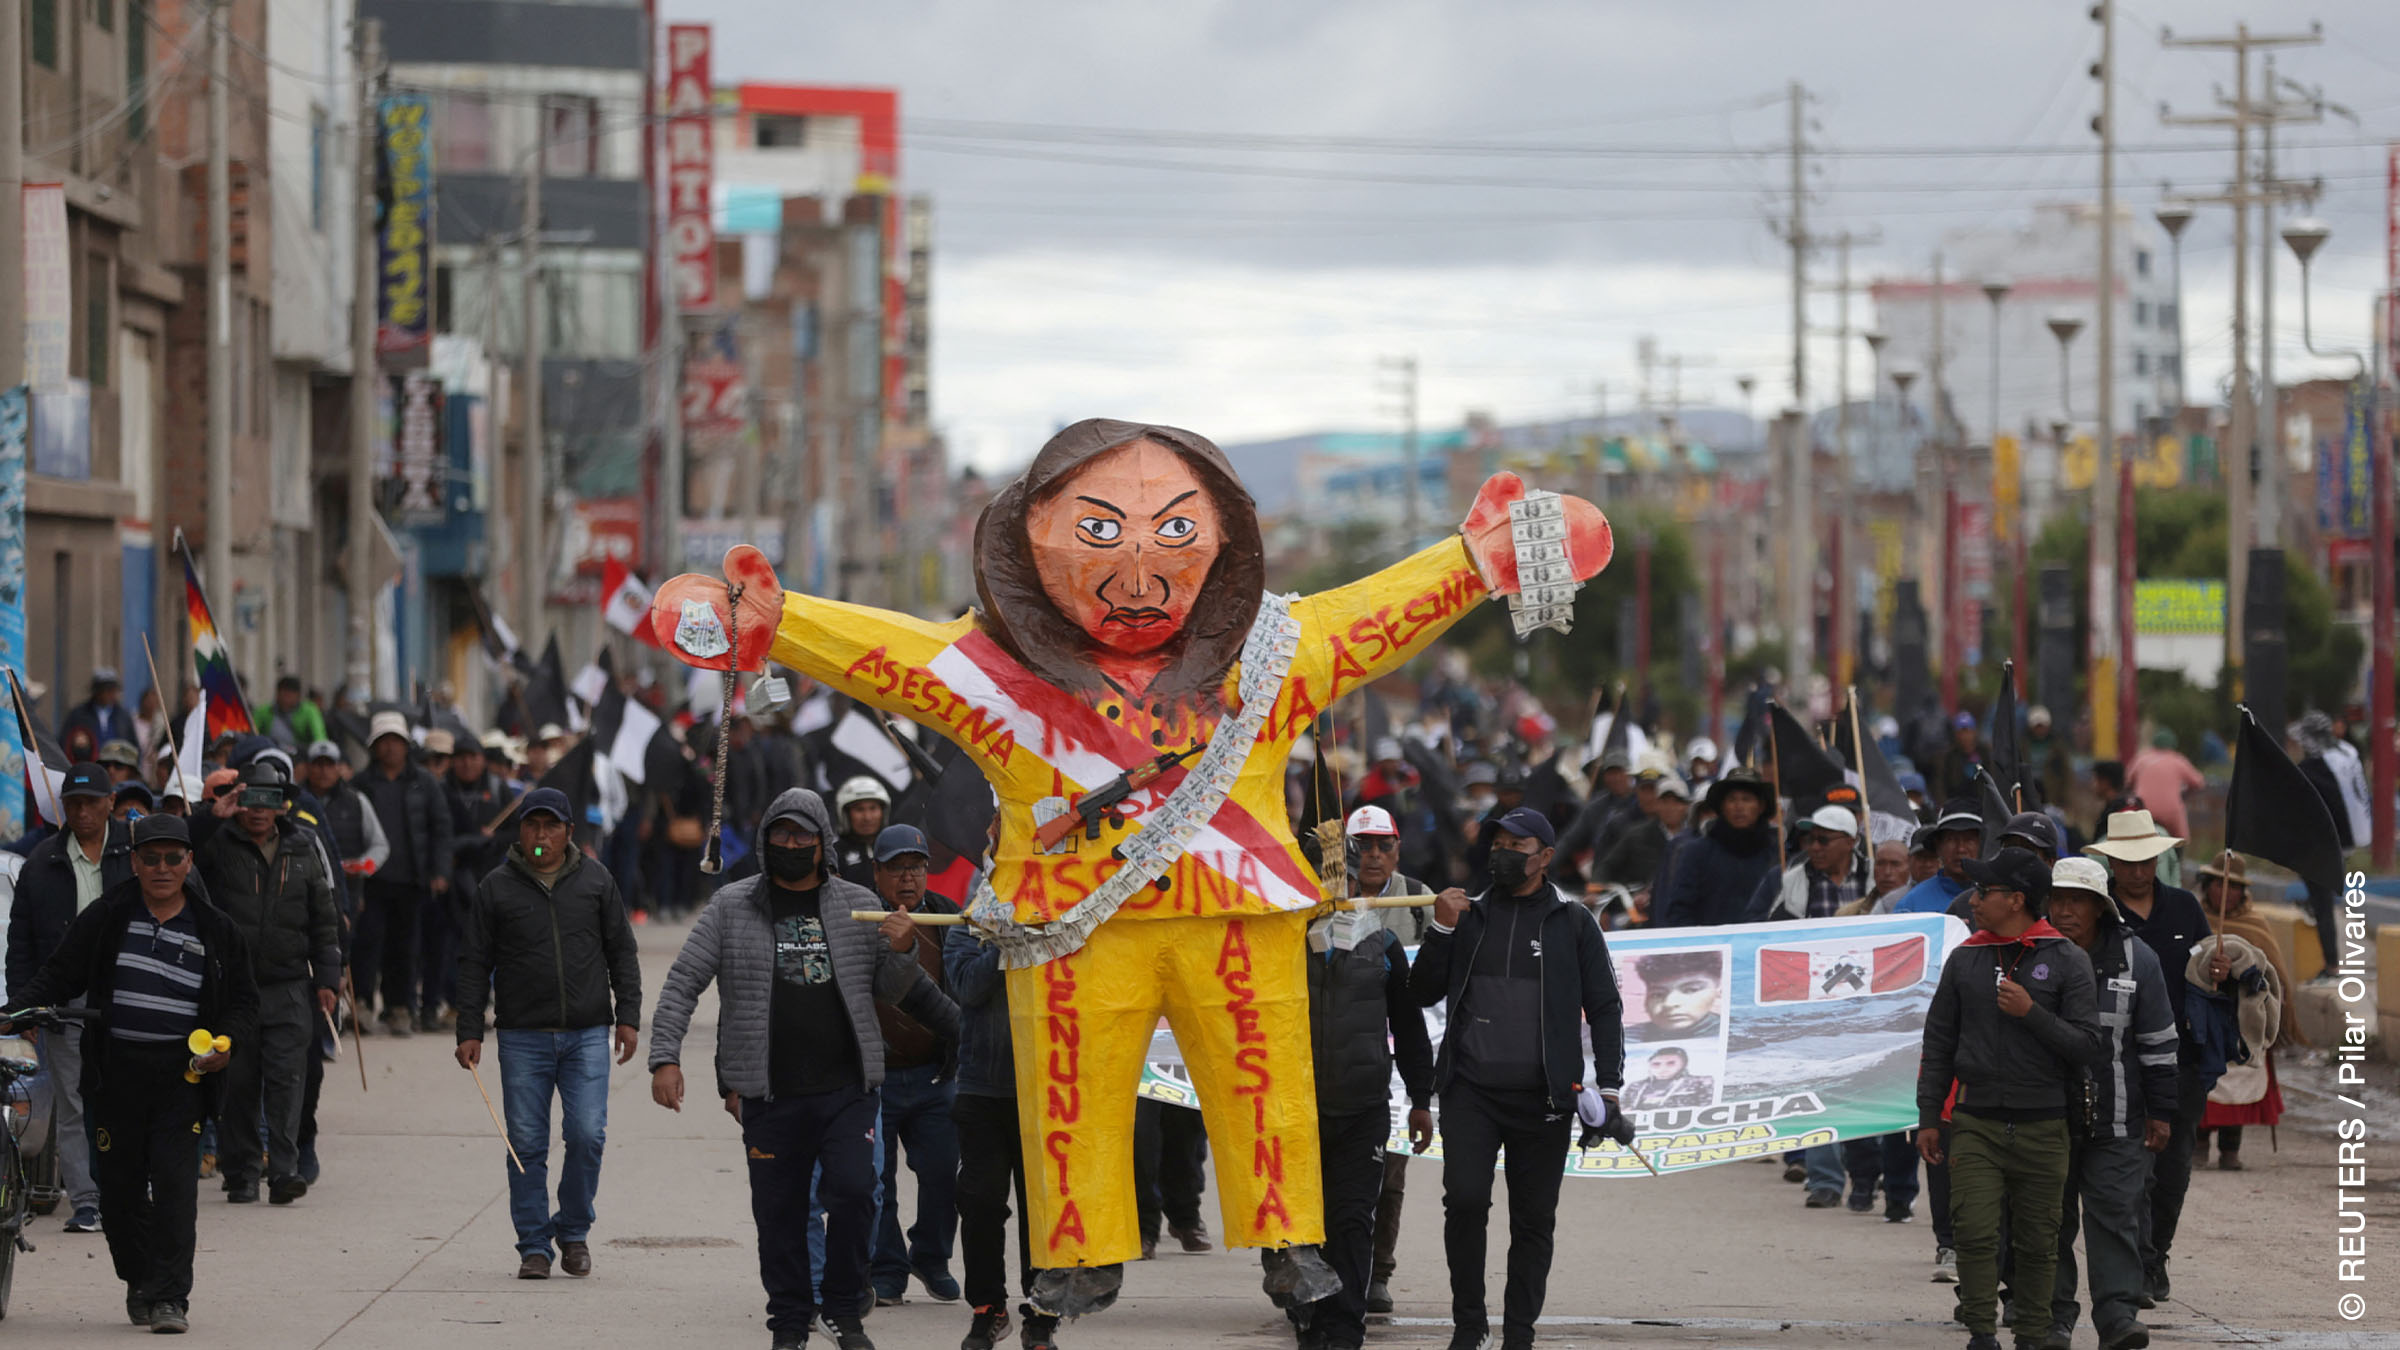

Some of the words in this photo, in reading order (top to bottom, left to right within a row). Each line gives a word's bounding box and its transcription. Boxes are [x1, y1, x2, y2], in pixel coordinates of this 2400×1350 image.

[672, 29, 708, 300] PARTOS
[1329, 567, 1488, 703] ASESINA
[844, 645, 1015, 768] ASESINA
[1215, 918, 1293, 1232] ASESINA
[1639, 1125, 1770, 1151] PARA
[1581, 1156, 1649, 1169] DE
[1664, 1131, 1833, 1167] ENERO
